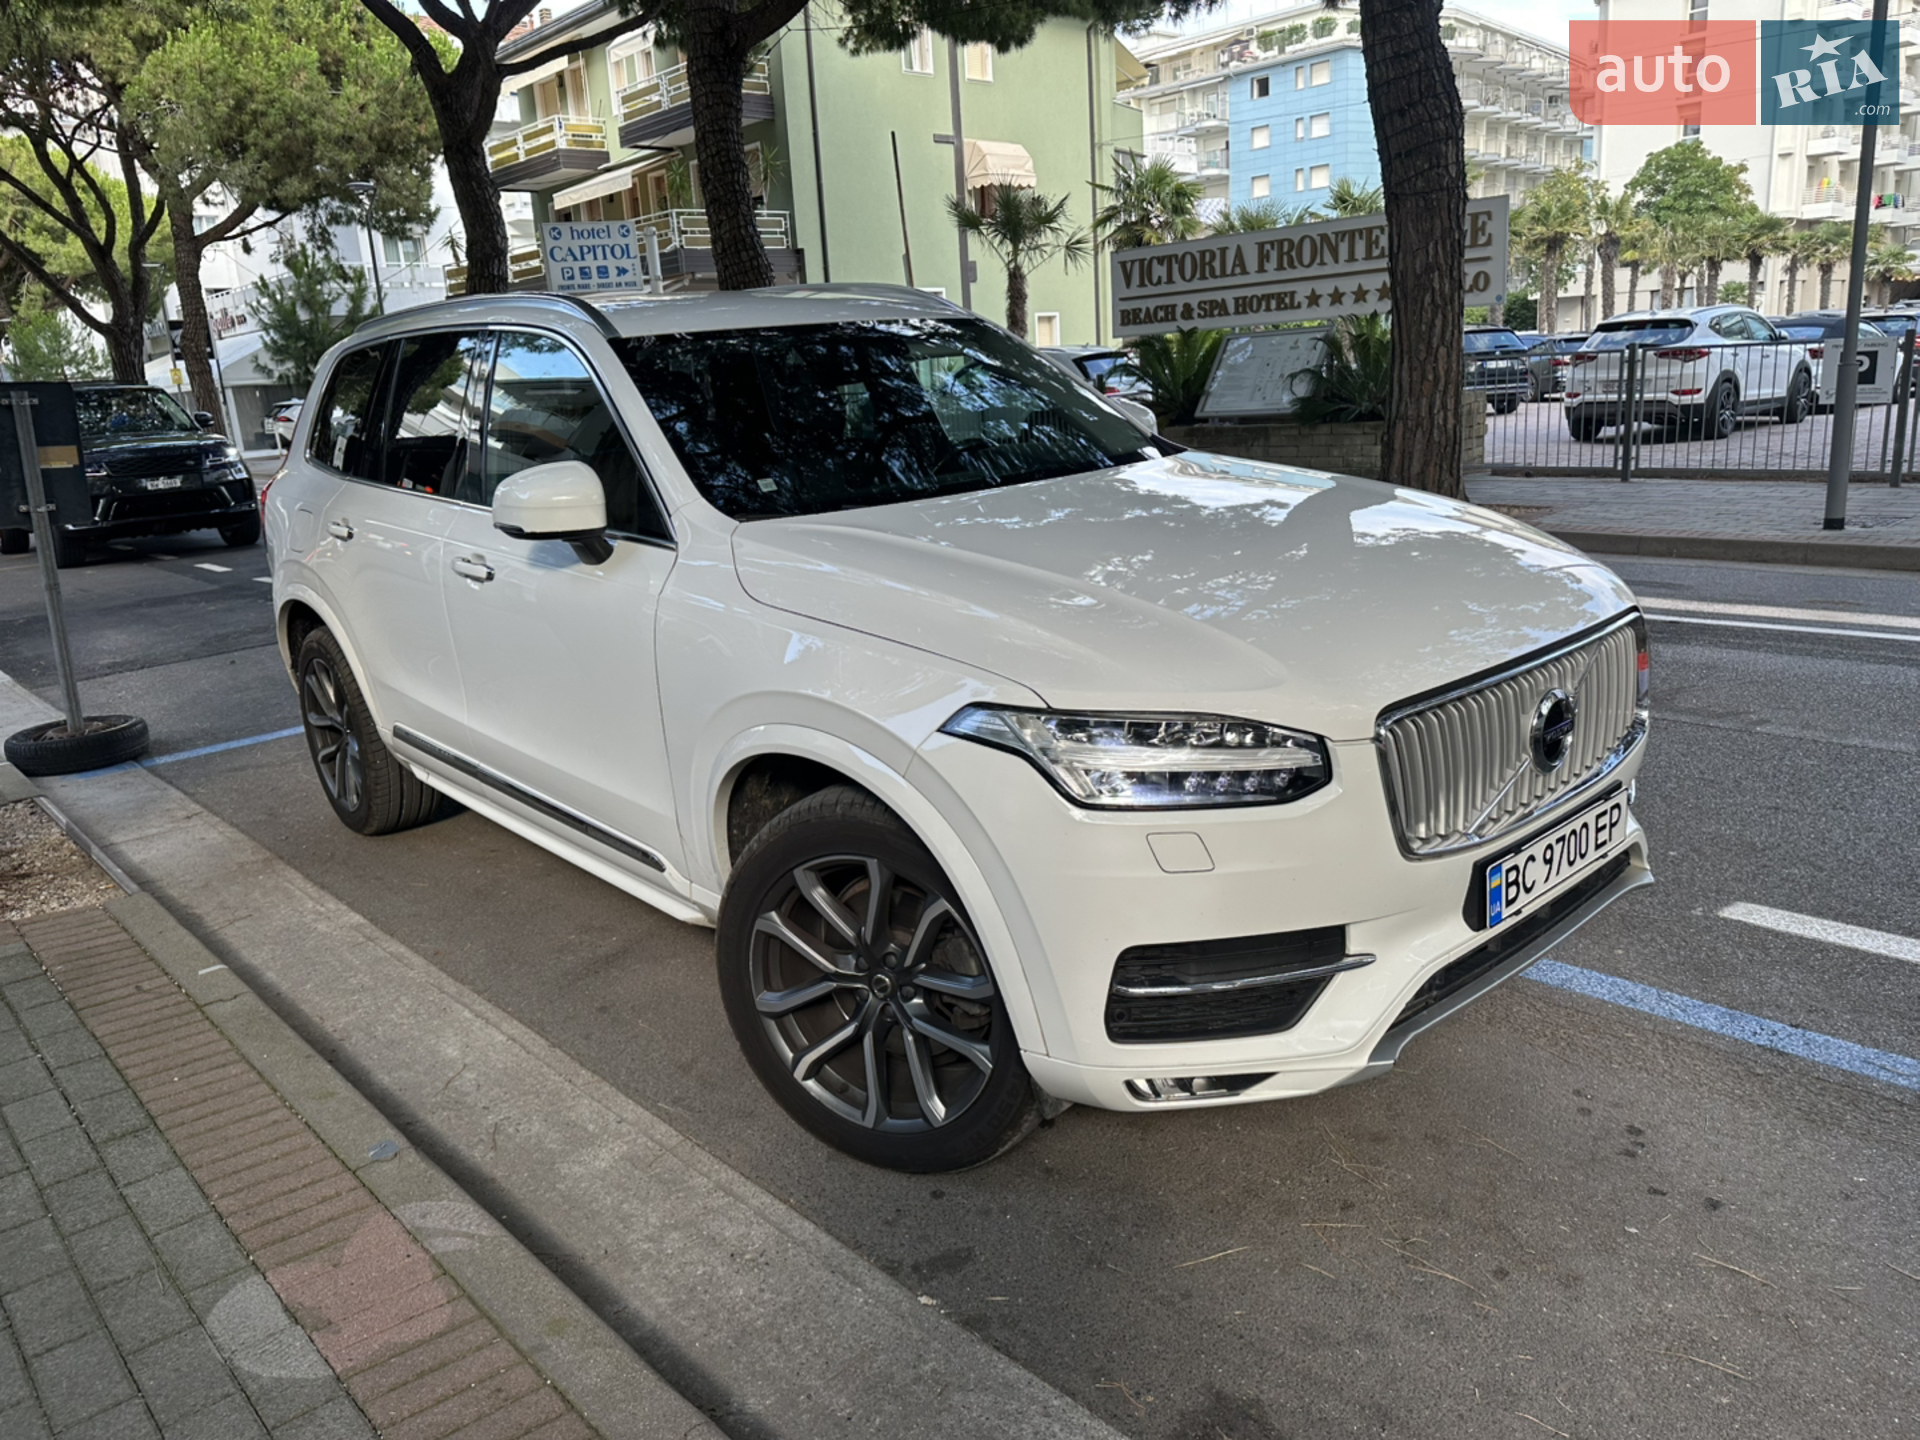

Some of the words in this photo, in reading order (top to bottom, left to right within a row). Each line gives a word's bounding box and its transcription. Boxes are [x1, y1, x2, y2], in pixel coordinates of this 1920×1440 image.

[569, 224, 611, 240] hotel
[549, 243, 638, 263] CAPITOL
[1117, 243, 1250, 290] VICTORIA
[1119, 303, 1178, 327] BEACH
[1180, 302, 1195, 321] &
[1197, 297, 1231, 319] SPA
[1232, 290, 1302, 315] HOTEL
[1505, 853, 1537, 908] BC
[1542, 821, 1590, 884] 9700
[1594, 802, 1622, 851] EP
[1490, 901, 1500, 916] UA
